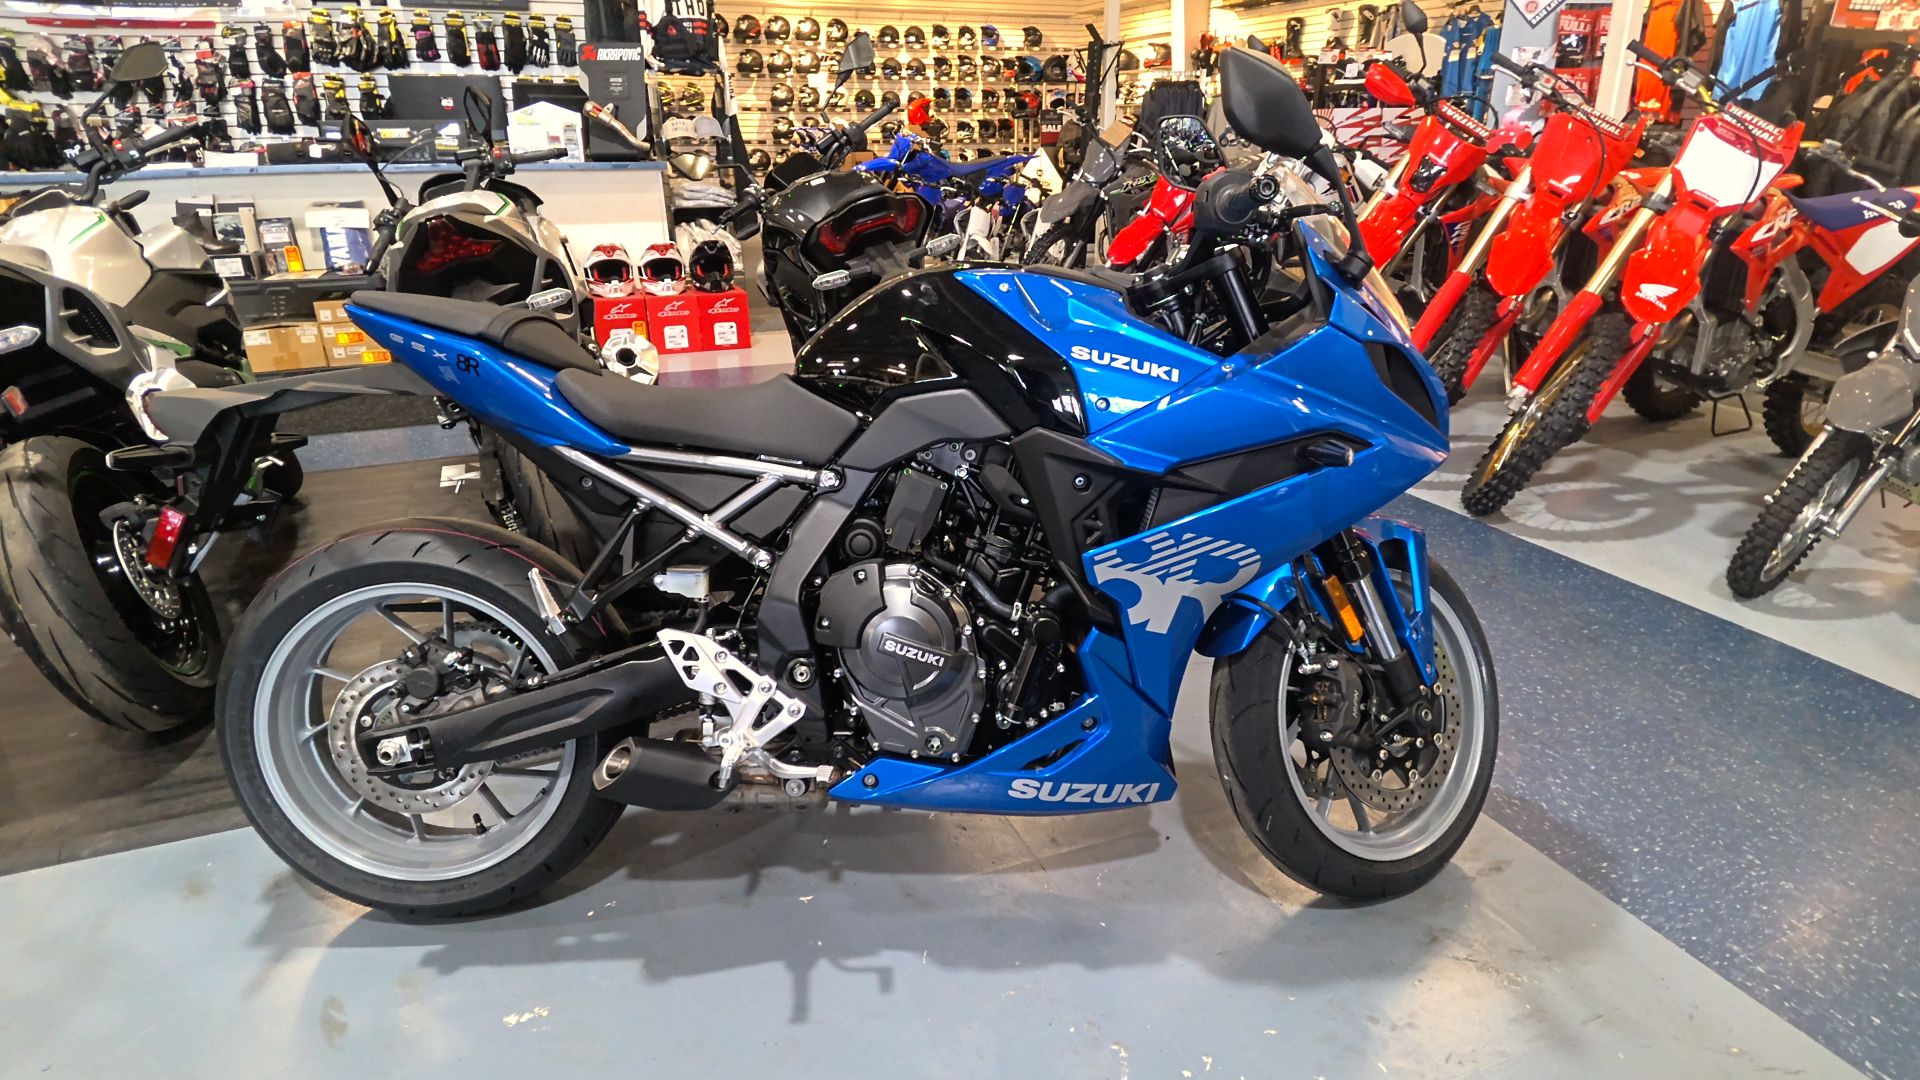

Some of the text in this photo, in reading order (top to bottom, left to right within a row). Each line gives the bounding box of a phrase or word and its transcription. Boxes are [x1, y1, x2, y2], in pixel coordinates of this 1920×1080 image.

[1723, 114, 1775, 143] RETHAL
[1729, 106, 1780, 135] RENTHAL
[456, 353, 481, 377] 8R
[1070, 345, 1180, 383] SUZUKI
[884, 640, 945, 668] SUZUKI
[1008, 778, 1161, 803] SUZUKI
